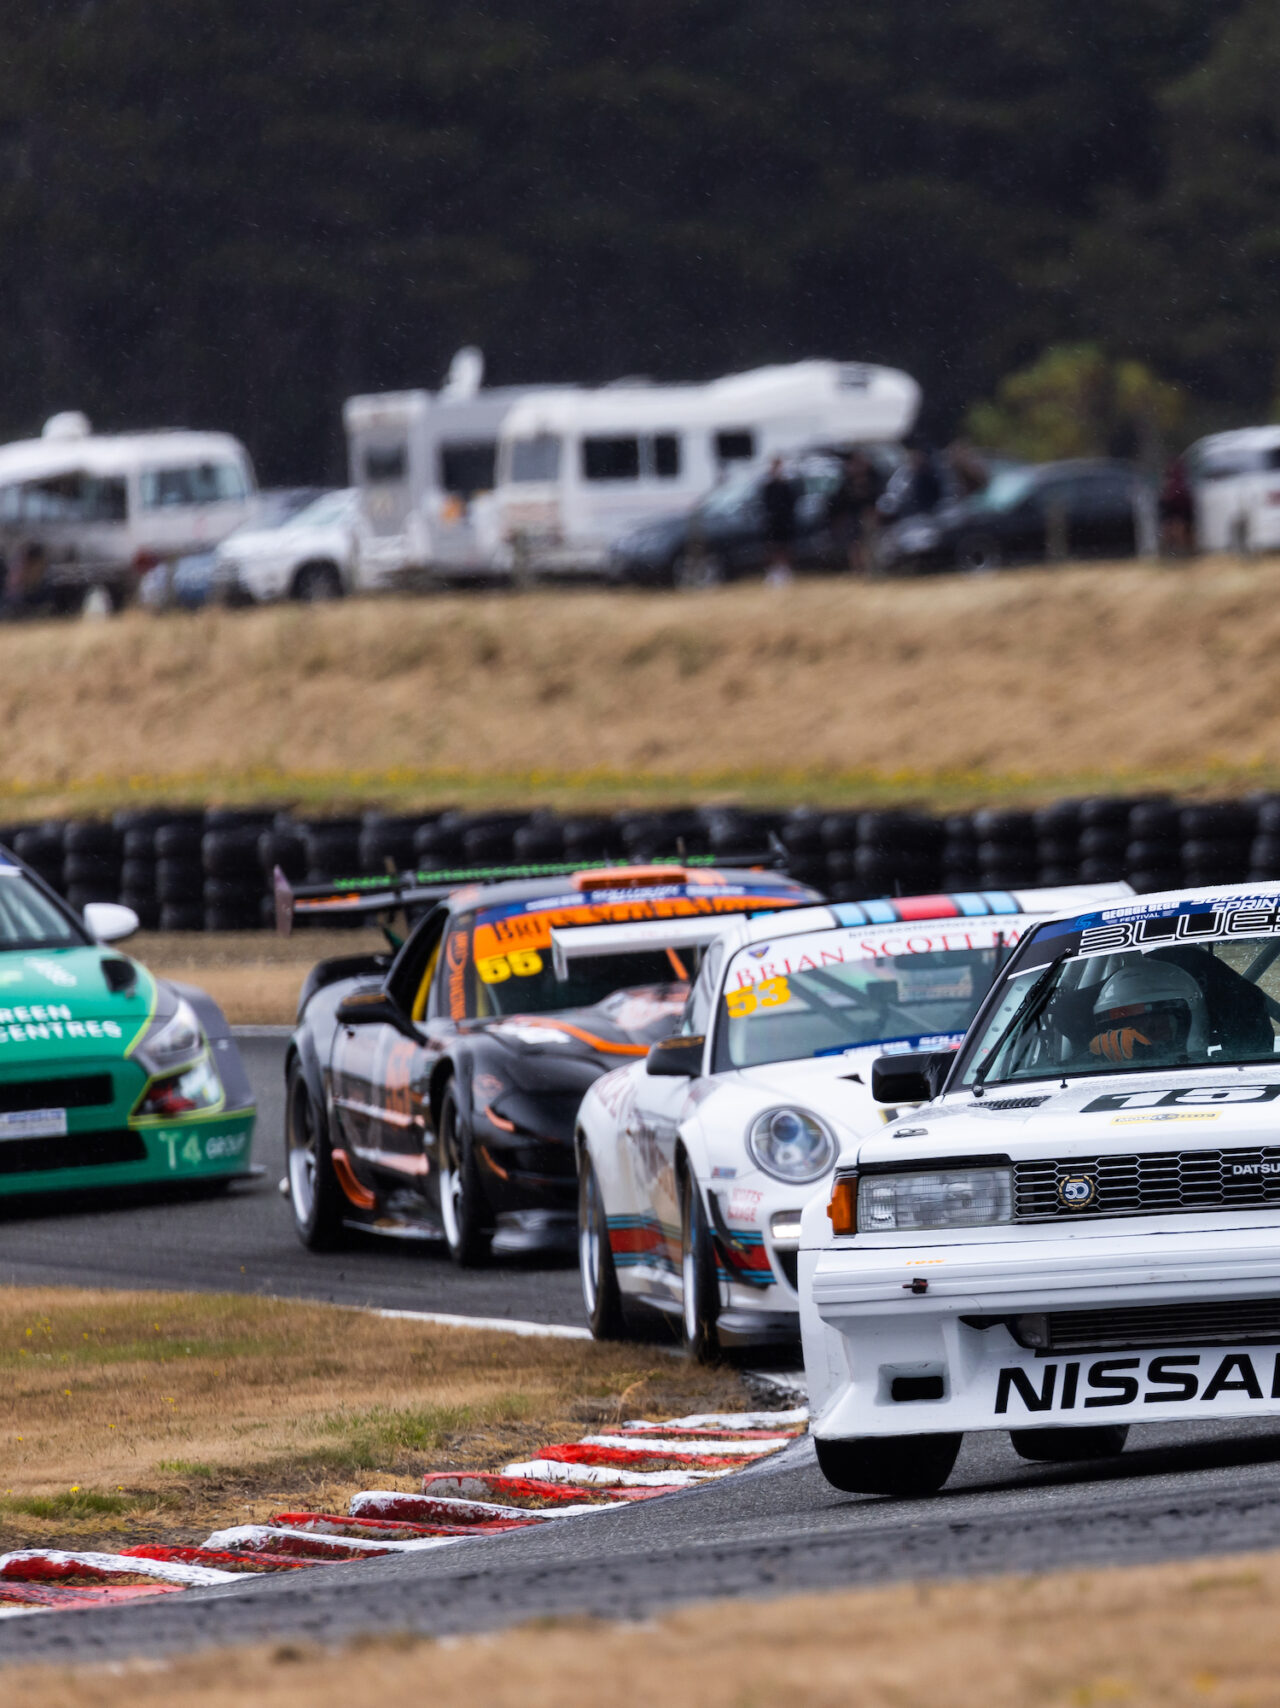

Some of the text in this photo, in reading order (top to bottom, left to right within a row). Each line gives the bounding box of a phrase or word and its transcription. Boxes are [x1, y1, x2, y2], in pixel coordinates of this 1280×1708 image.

[1119, 911, 1160, 923] FESTIVAL
[477, 947, 543, 985] 55
[734, 946, 845, 990] BRIAN
[859, 931, 974, 961] SCOTT
[725, 976, 792, 1018] 53
[1111, 1085, 1269, 1109] 15
[1064, 1182, 1090, 1200] 50
